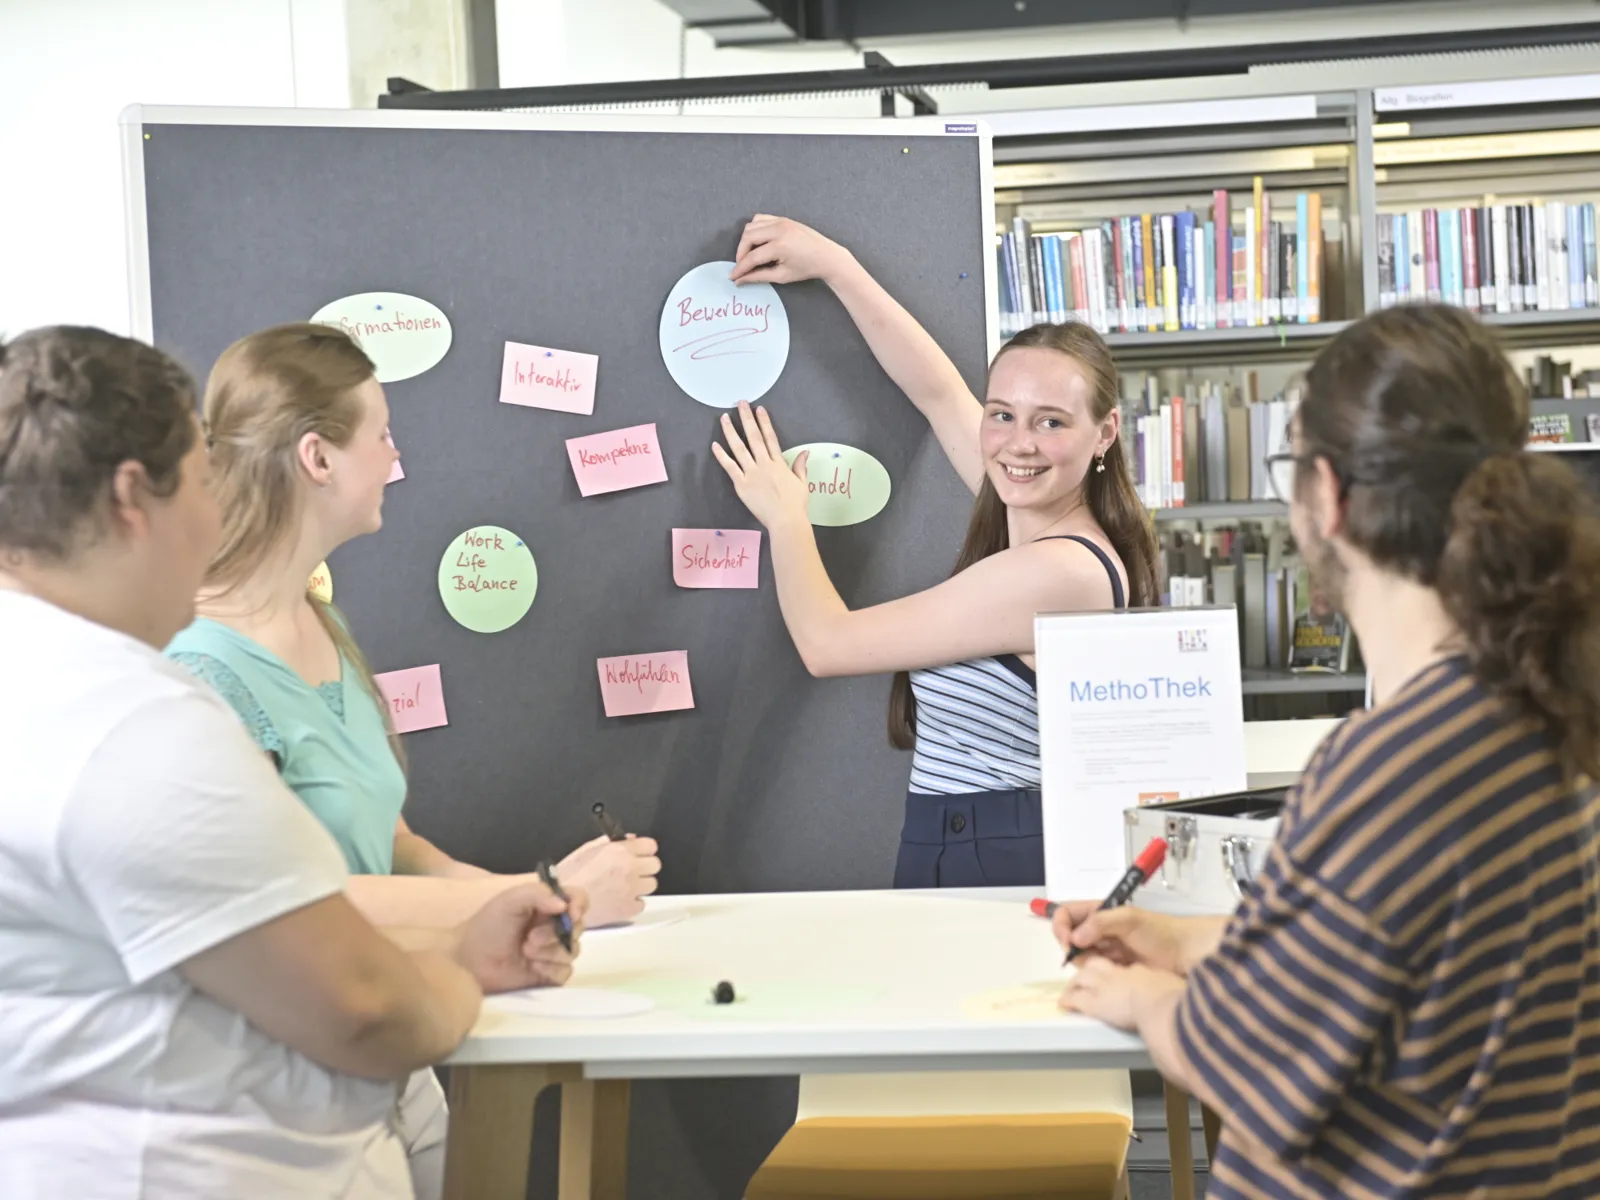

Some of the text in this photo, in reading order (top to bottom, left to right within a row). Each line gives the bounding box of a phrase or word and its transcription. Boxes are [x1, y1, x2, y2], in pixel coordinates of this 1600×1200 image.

[514, 361, 581, 392] Interaktiv
[578, 439, 651, 468] Kompetenz
[808, 467, 852, 499] andel
[464, 531, 504, 551] Work
[456, 552, 487, 572] Life
[682, 543, 749, 570] Sicherheit
[392, 682, 421, 713] zial
[1070, 676, 1212, 702] MethoThek
